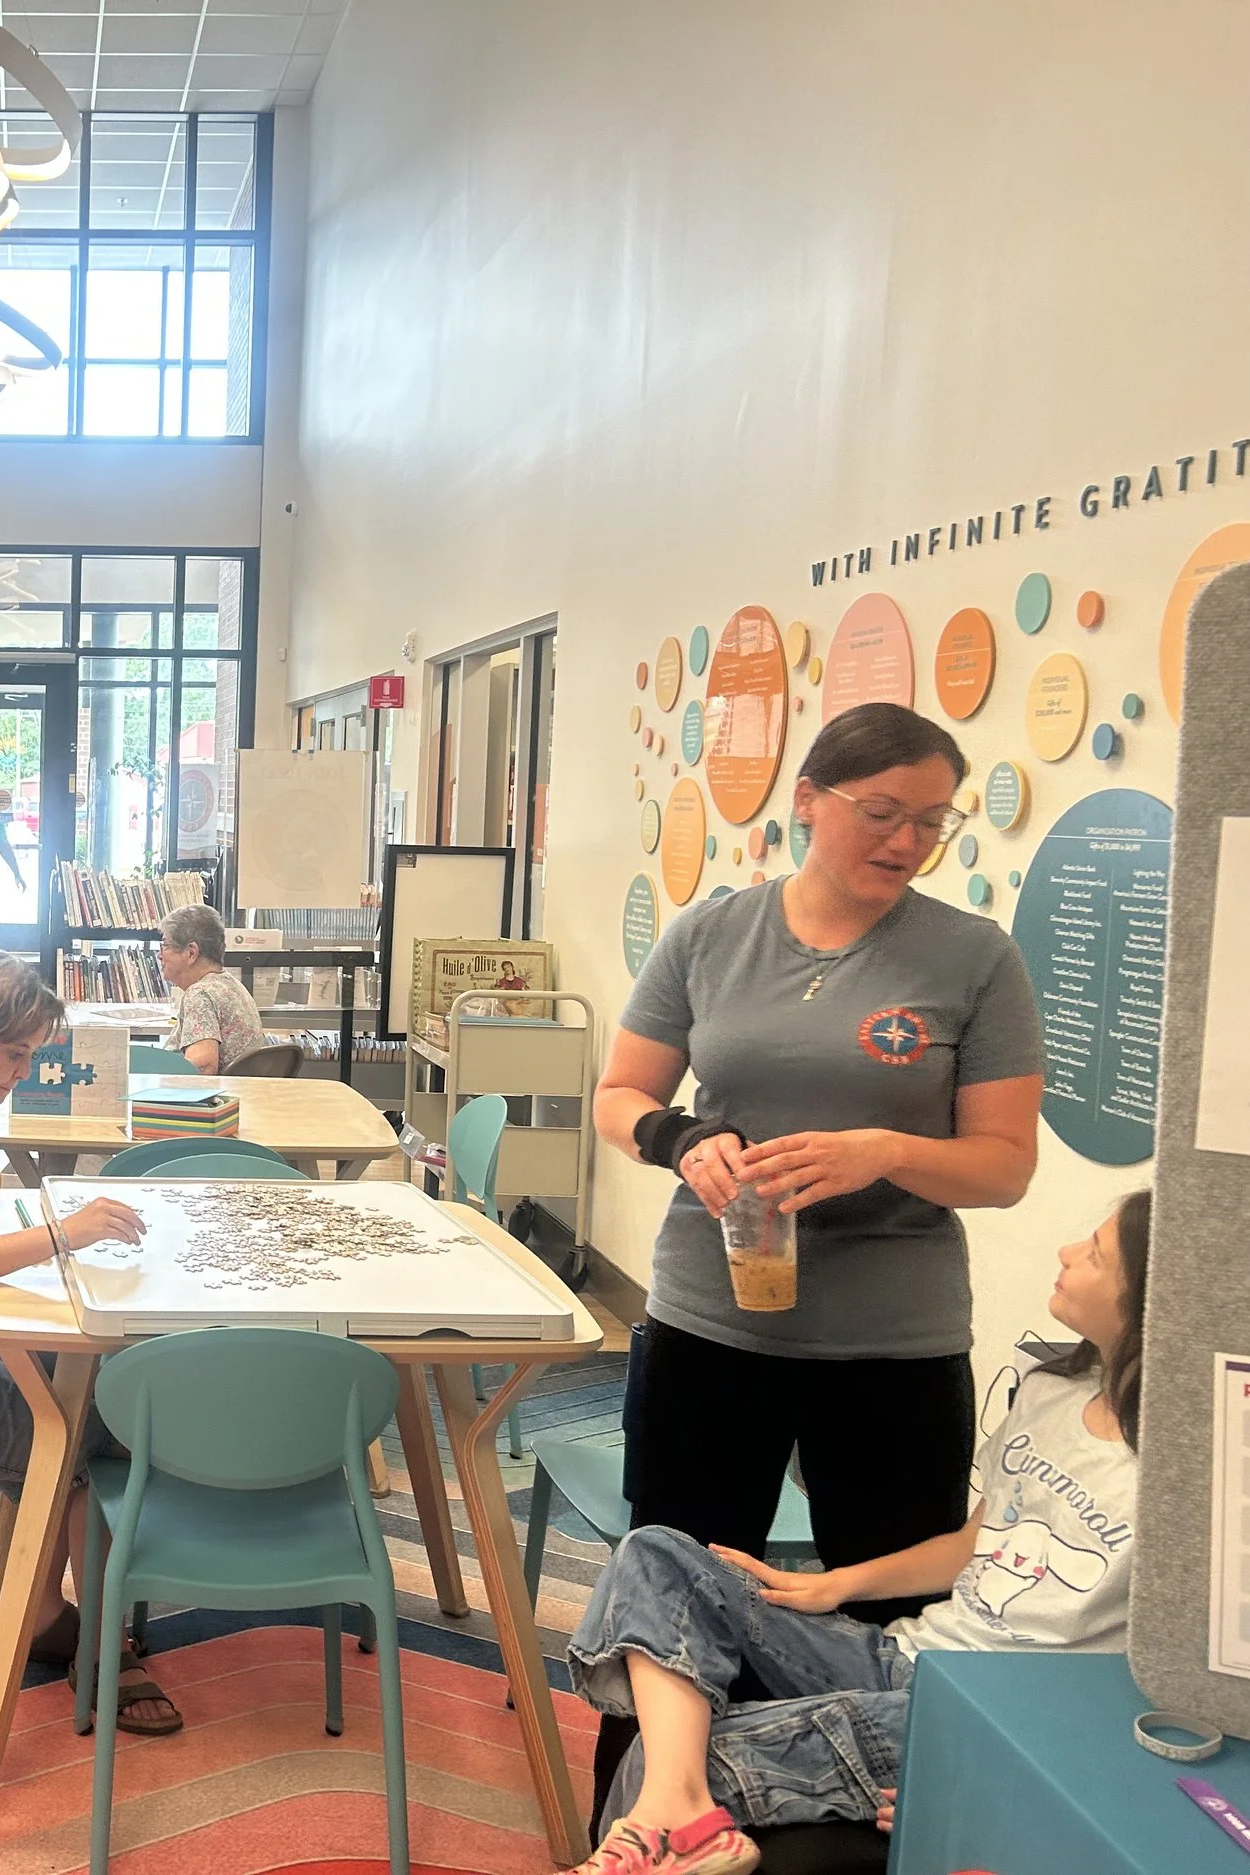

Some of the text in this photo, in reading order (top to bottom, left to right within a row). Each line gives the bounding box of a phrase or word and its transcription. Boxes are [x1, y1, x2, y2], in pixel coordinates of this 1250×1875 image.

[811, 546, 872, 587] WITH
[890, 495, 1052, 566] INFINITE
[442, 957, 465, 976] Huile
